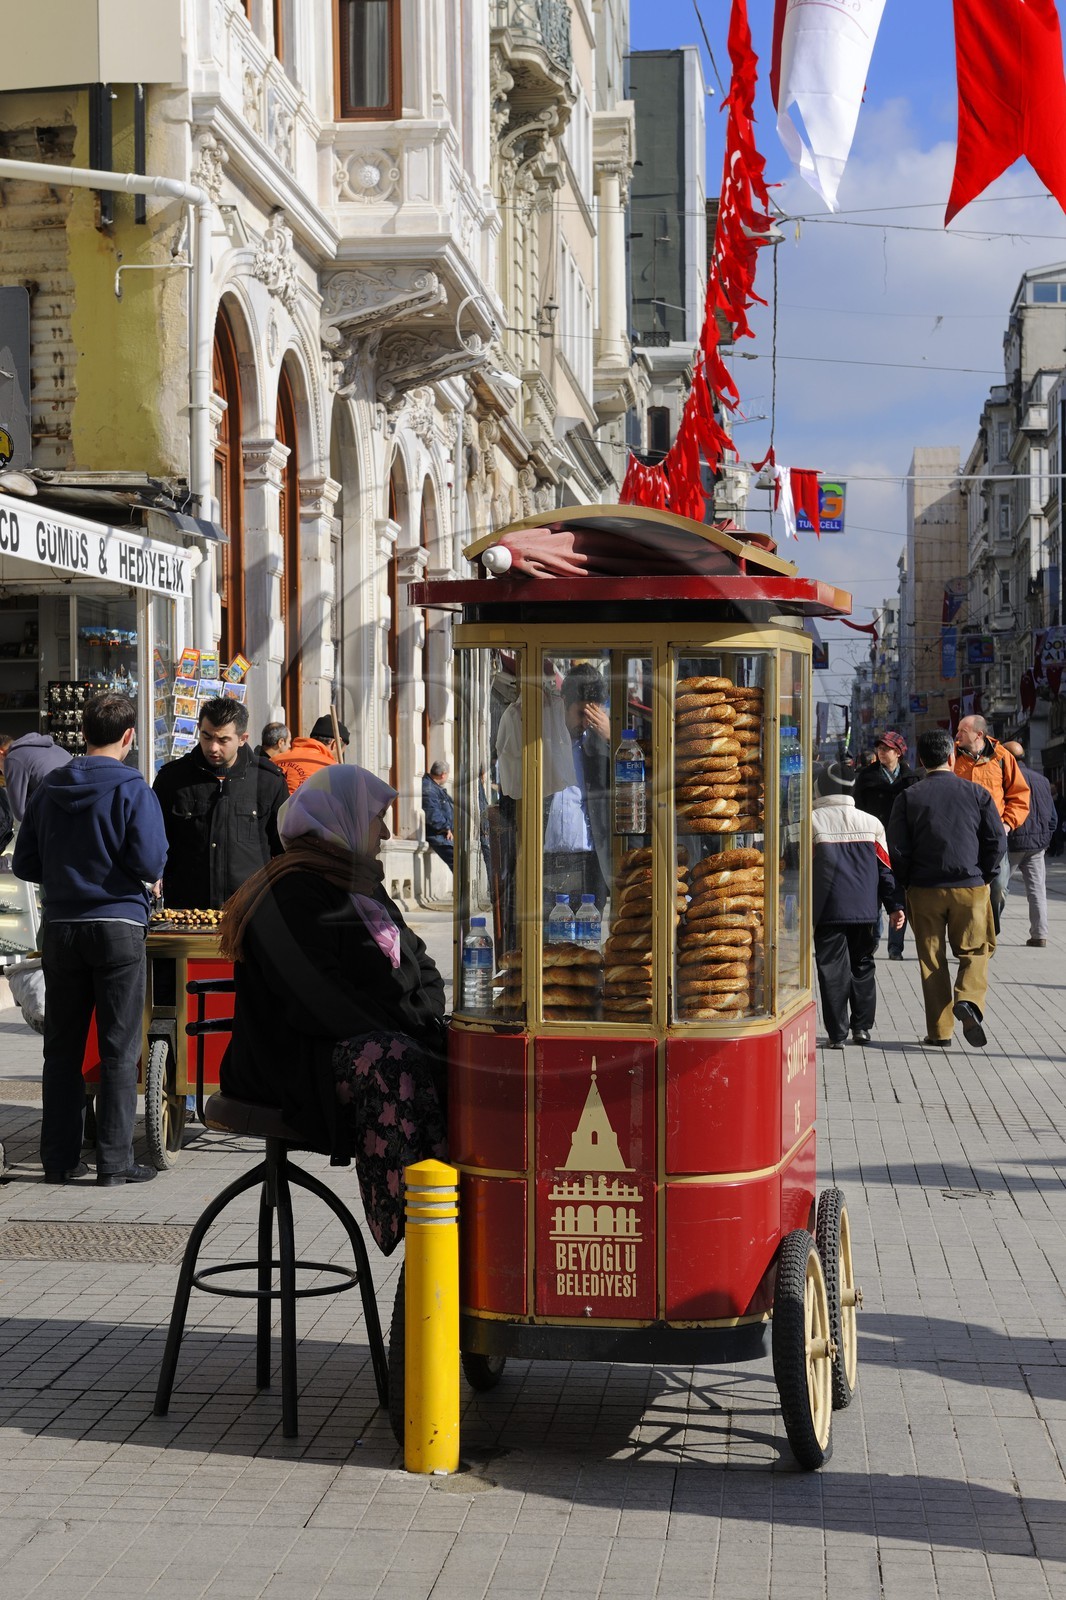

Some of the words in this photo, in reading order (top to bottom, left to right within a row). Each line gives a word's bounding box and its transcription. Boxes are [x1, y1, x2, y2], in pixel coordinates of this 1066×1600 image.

[0, 508, 19, 553] CD
[36, 520, 89, 571] GÜMÜŞ
[99, 537, 108, 575] &
[119, 542, 184, 593] HEDİYELİK
[556, 1237, 636, 1272] BEYOĞLU
[556, 1272, 637, 1298] BELEDİYESİ
